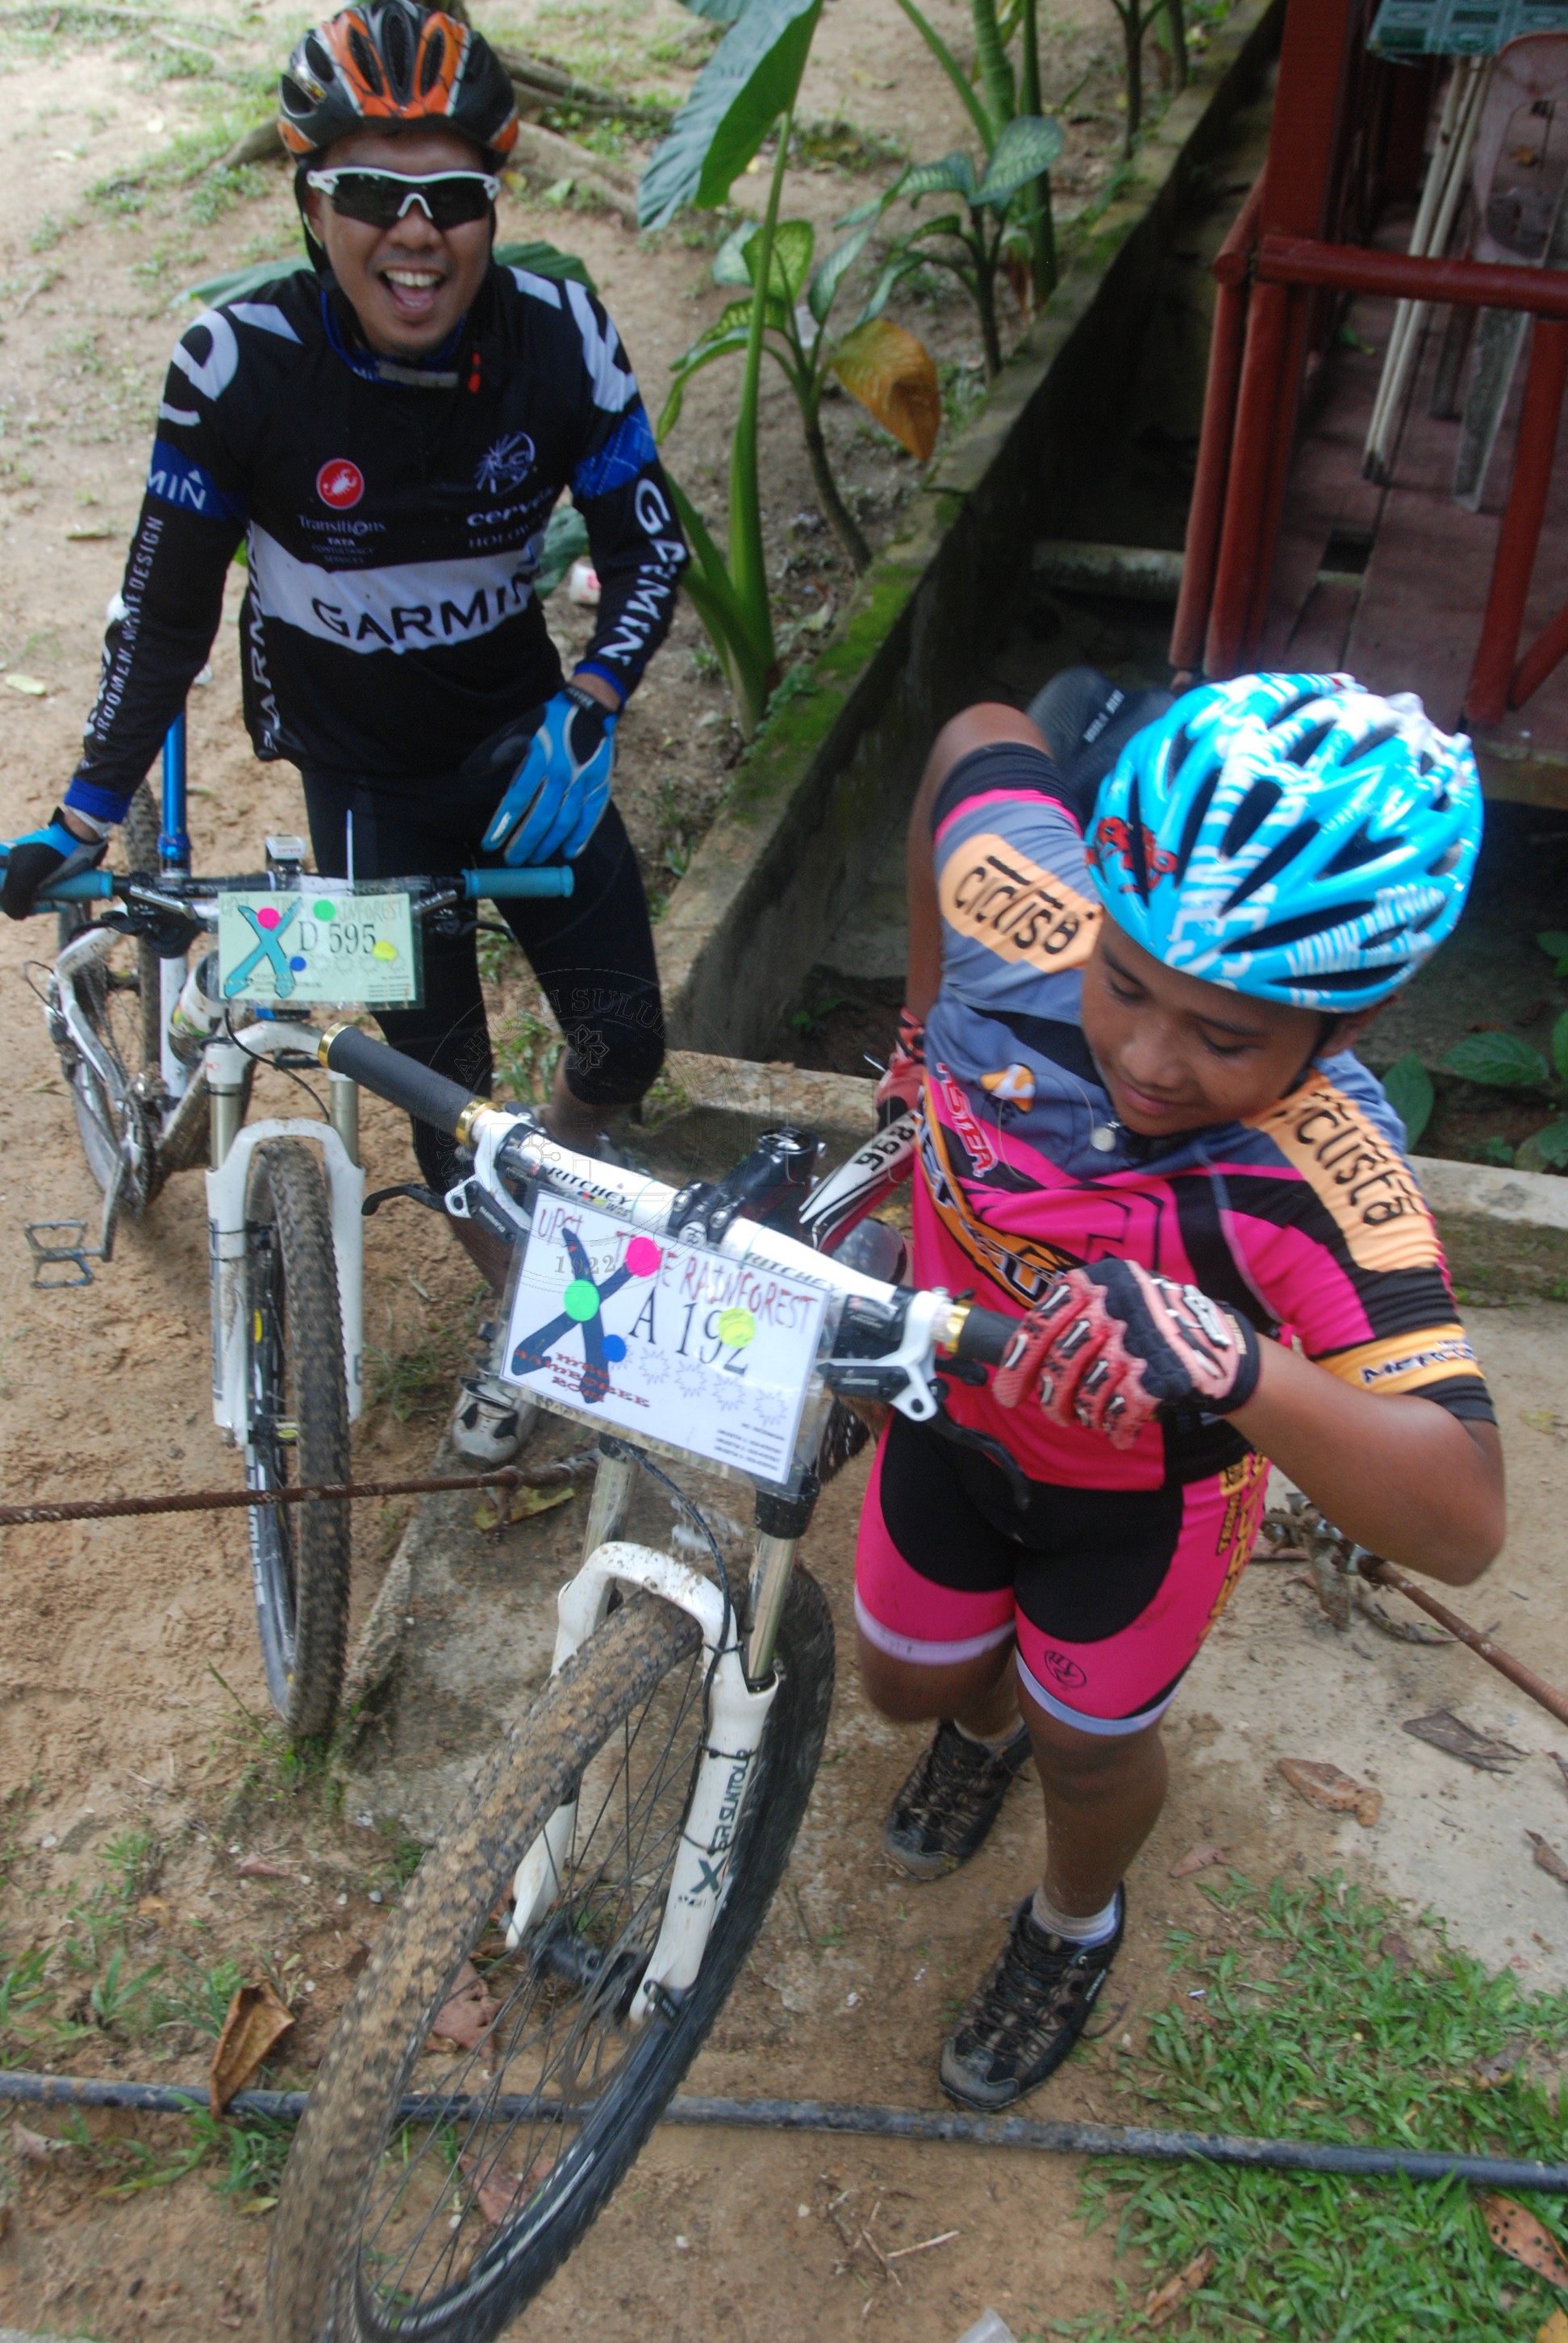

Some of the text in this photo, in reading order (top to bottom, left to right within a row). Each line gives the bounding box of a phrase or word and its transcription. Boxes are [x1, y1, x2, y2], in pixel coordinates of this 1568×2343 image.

[311, 566, 540, 645] GARMIN
[298, 921, 377, 954] D 595
[548, 1167, 632, 1205] RITCHEY
[629, 1286, 657, 1345] A
